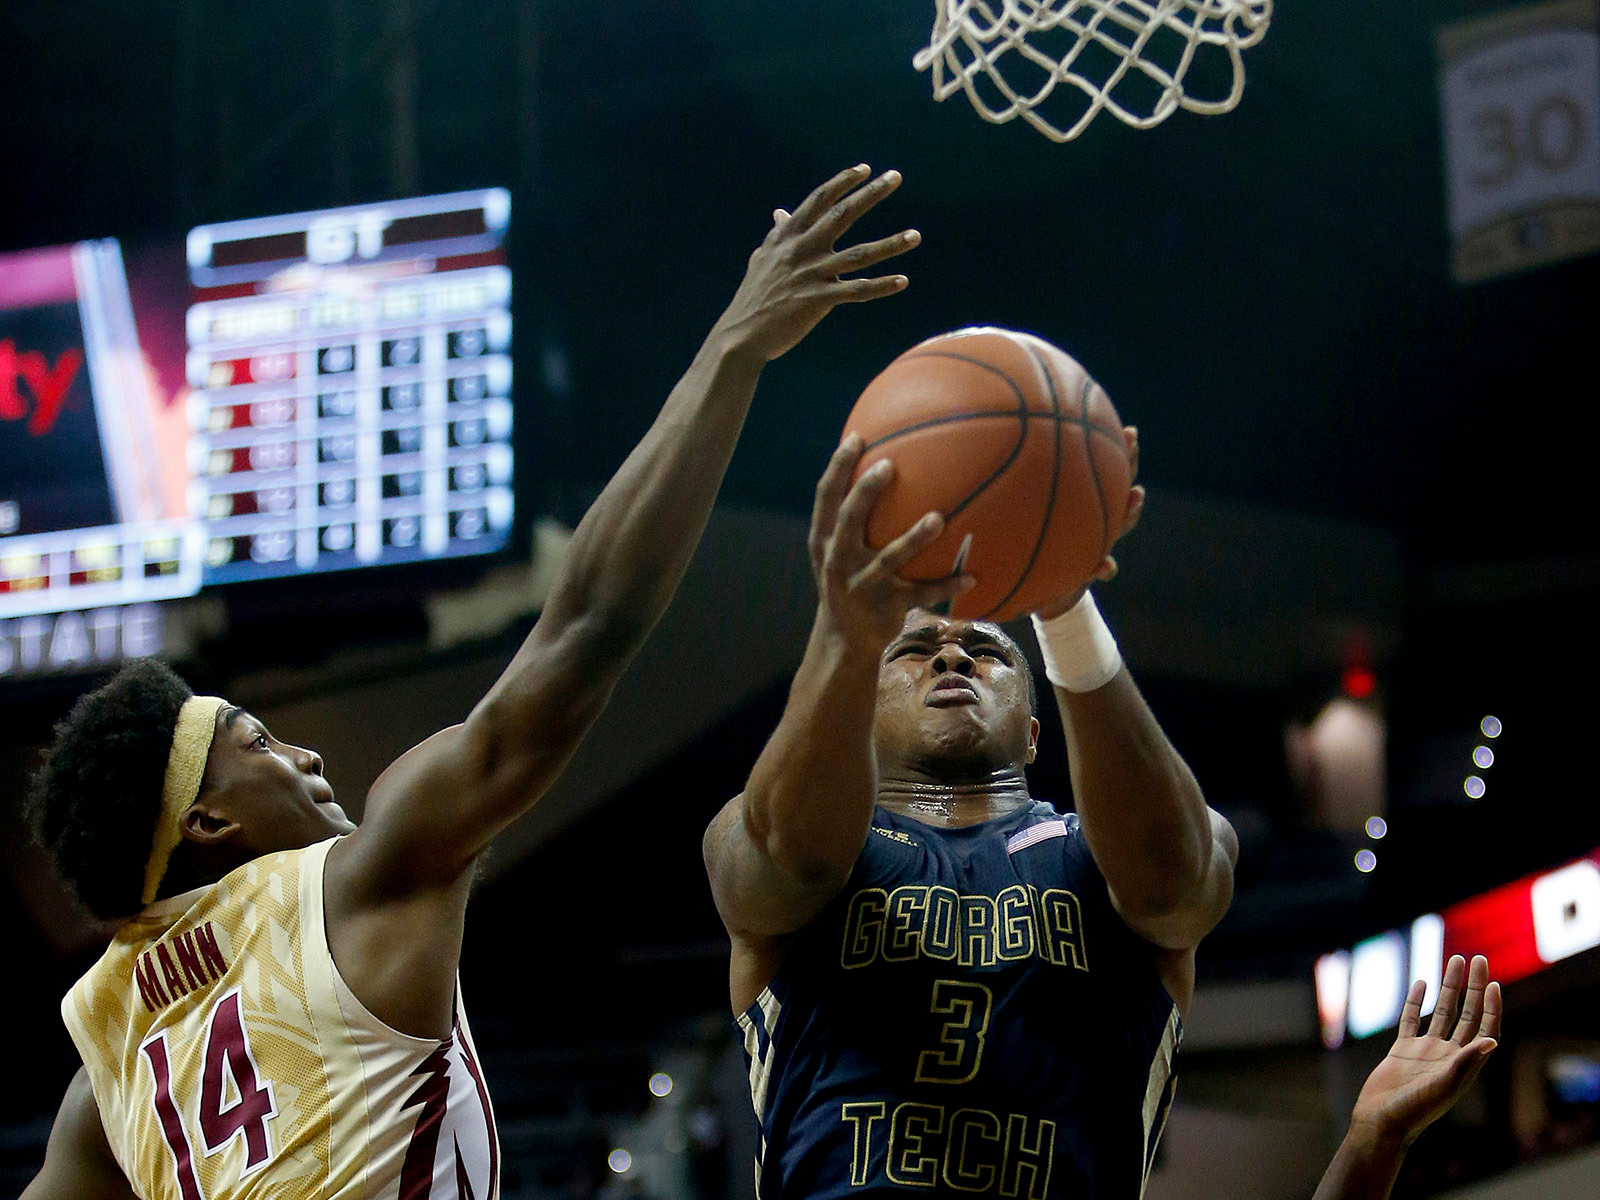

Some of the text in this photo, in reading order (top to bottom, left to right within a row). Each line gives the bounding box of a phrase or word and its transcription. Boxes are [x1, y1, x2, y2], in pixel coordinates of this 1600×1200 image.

[136, 921, 228, 1013] MANN
[841, 884, 1089, 972] GEORGIA
[915, 979, 993, 1085] 3
